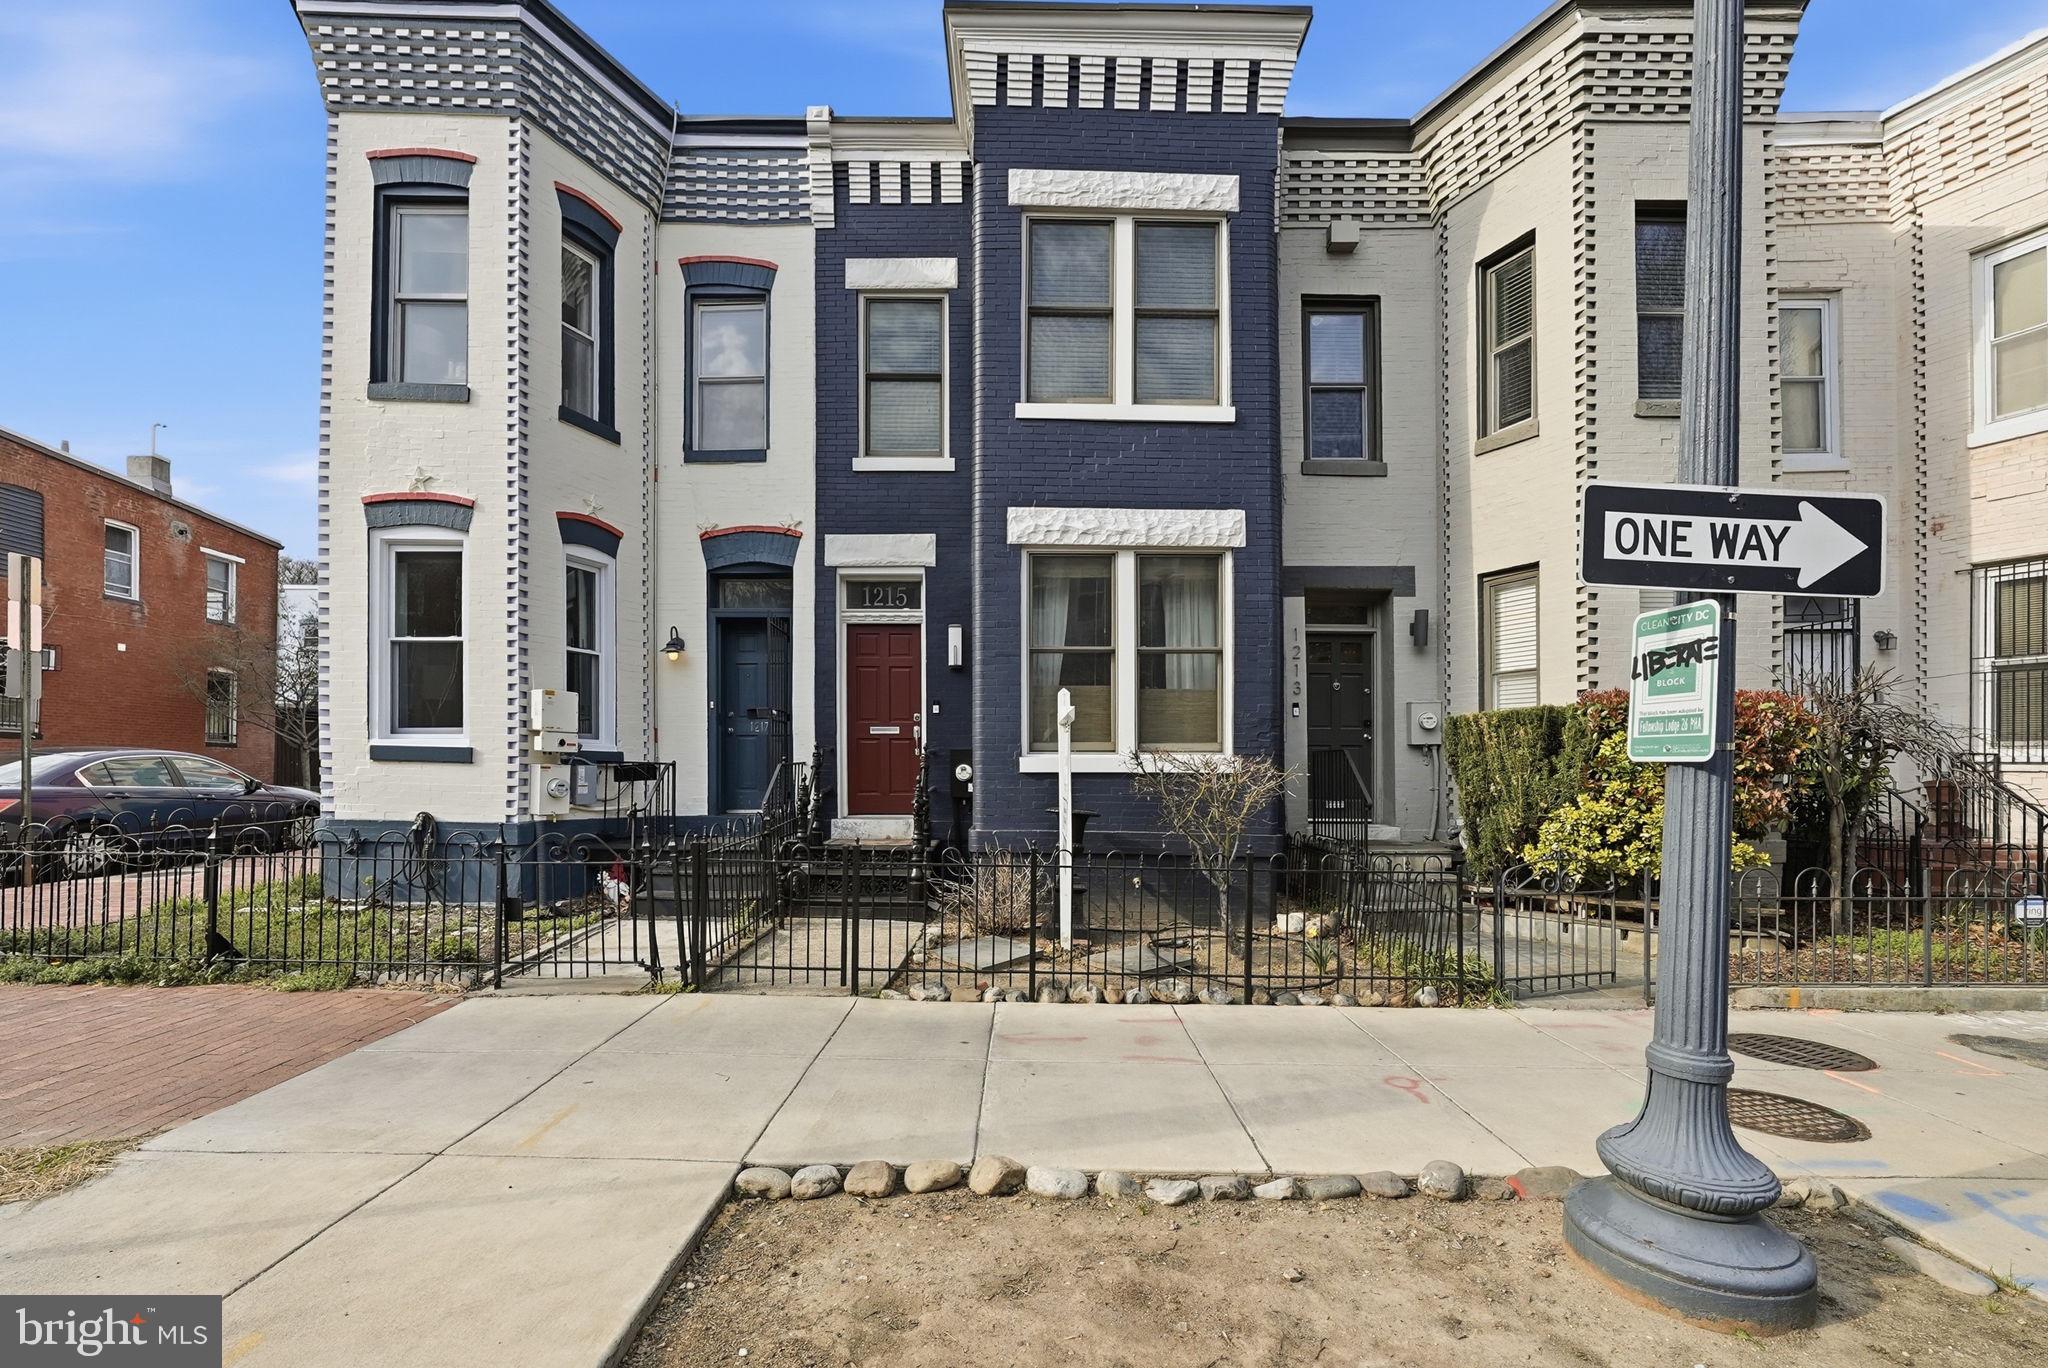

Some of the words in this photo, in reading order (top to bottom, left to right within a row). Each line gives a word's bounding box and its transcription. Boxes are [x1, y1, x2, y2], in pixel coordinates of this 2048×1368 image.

[1615, 517, 1693, 558] ONE
[1709, 522, 1792, 562] WAY
[863, 586, 907, 607] 1215
[1640, 619, 1670, 632] CLEAN
[1670, 612, 1693, 626] CITY
[1695, 609, 1710, 621] DC
[1292, 627, 1302, 696] 1213
[1656, 677, 1686, 687] BLOCK
[750, 721, 769, 732] 1217
[1640, 719, 1664, 733] Fellowship
[1665, 719, 1680, 734] Lodge
